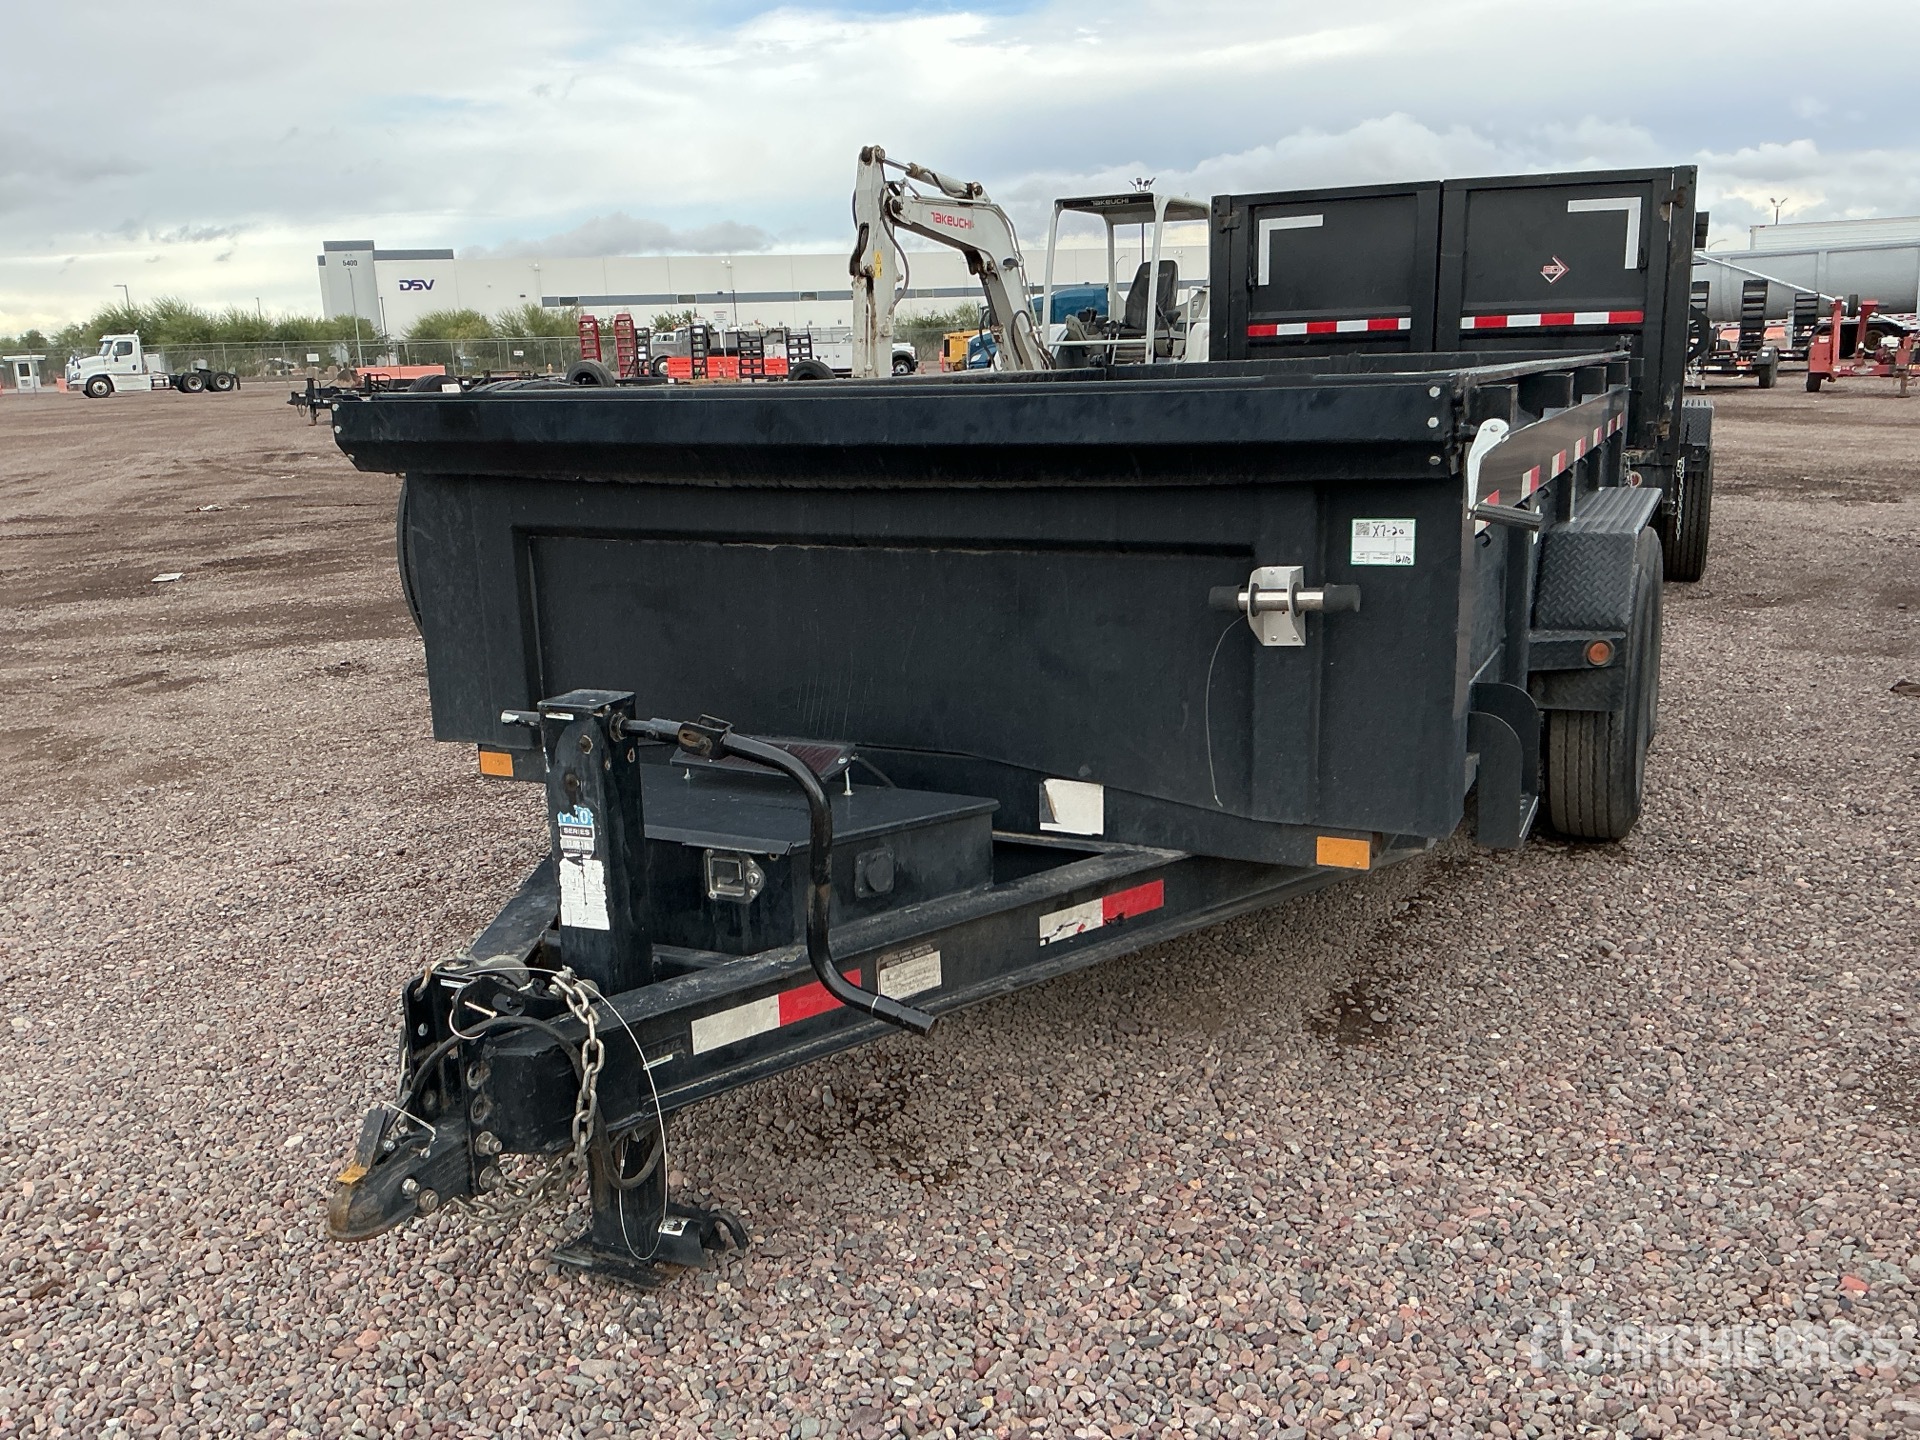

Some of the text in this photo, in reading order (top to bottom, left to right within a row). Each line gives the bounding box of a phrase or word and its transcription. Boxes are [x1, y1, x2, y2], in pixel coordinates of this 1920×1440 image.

[931, 211, 973, 230] TAKEUCHI
[342, 259, 358, 267] 5400
[399, 279, 435, 291] DSV
[563, 827, 591, 836] SERIES
